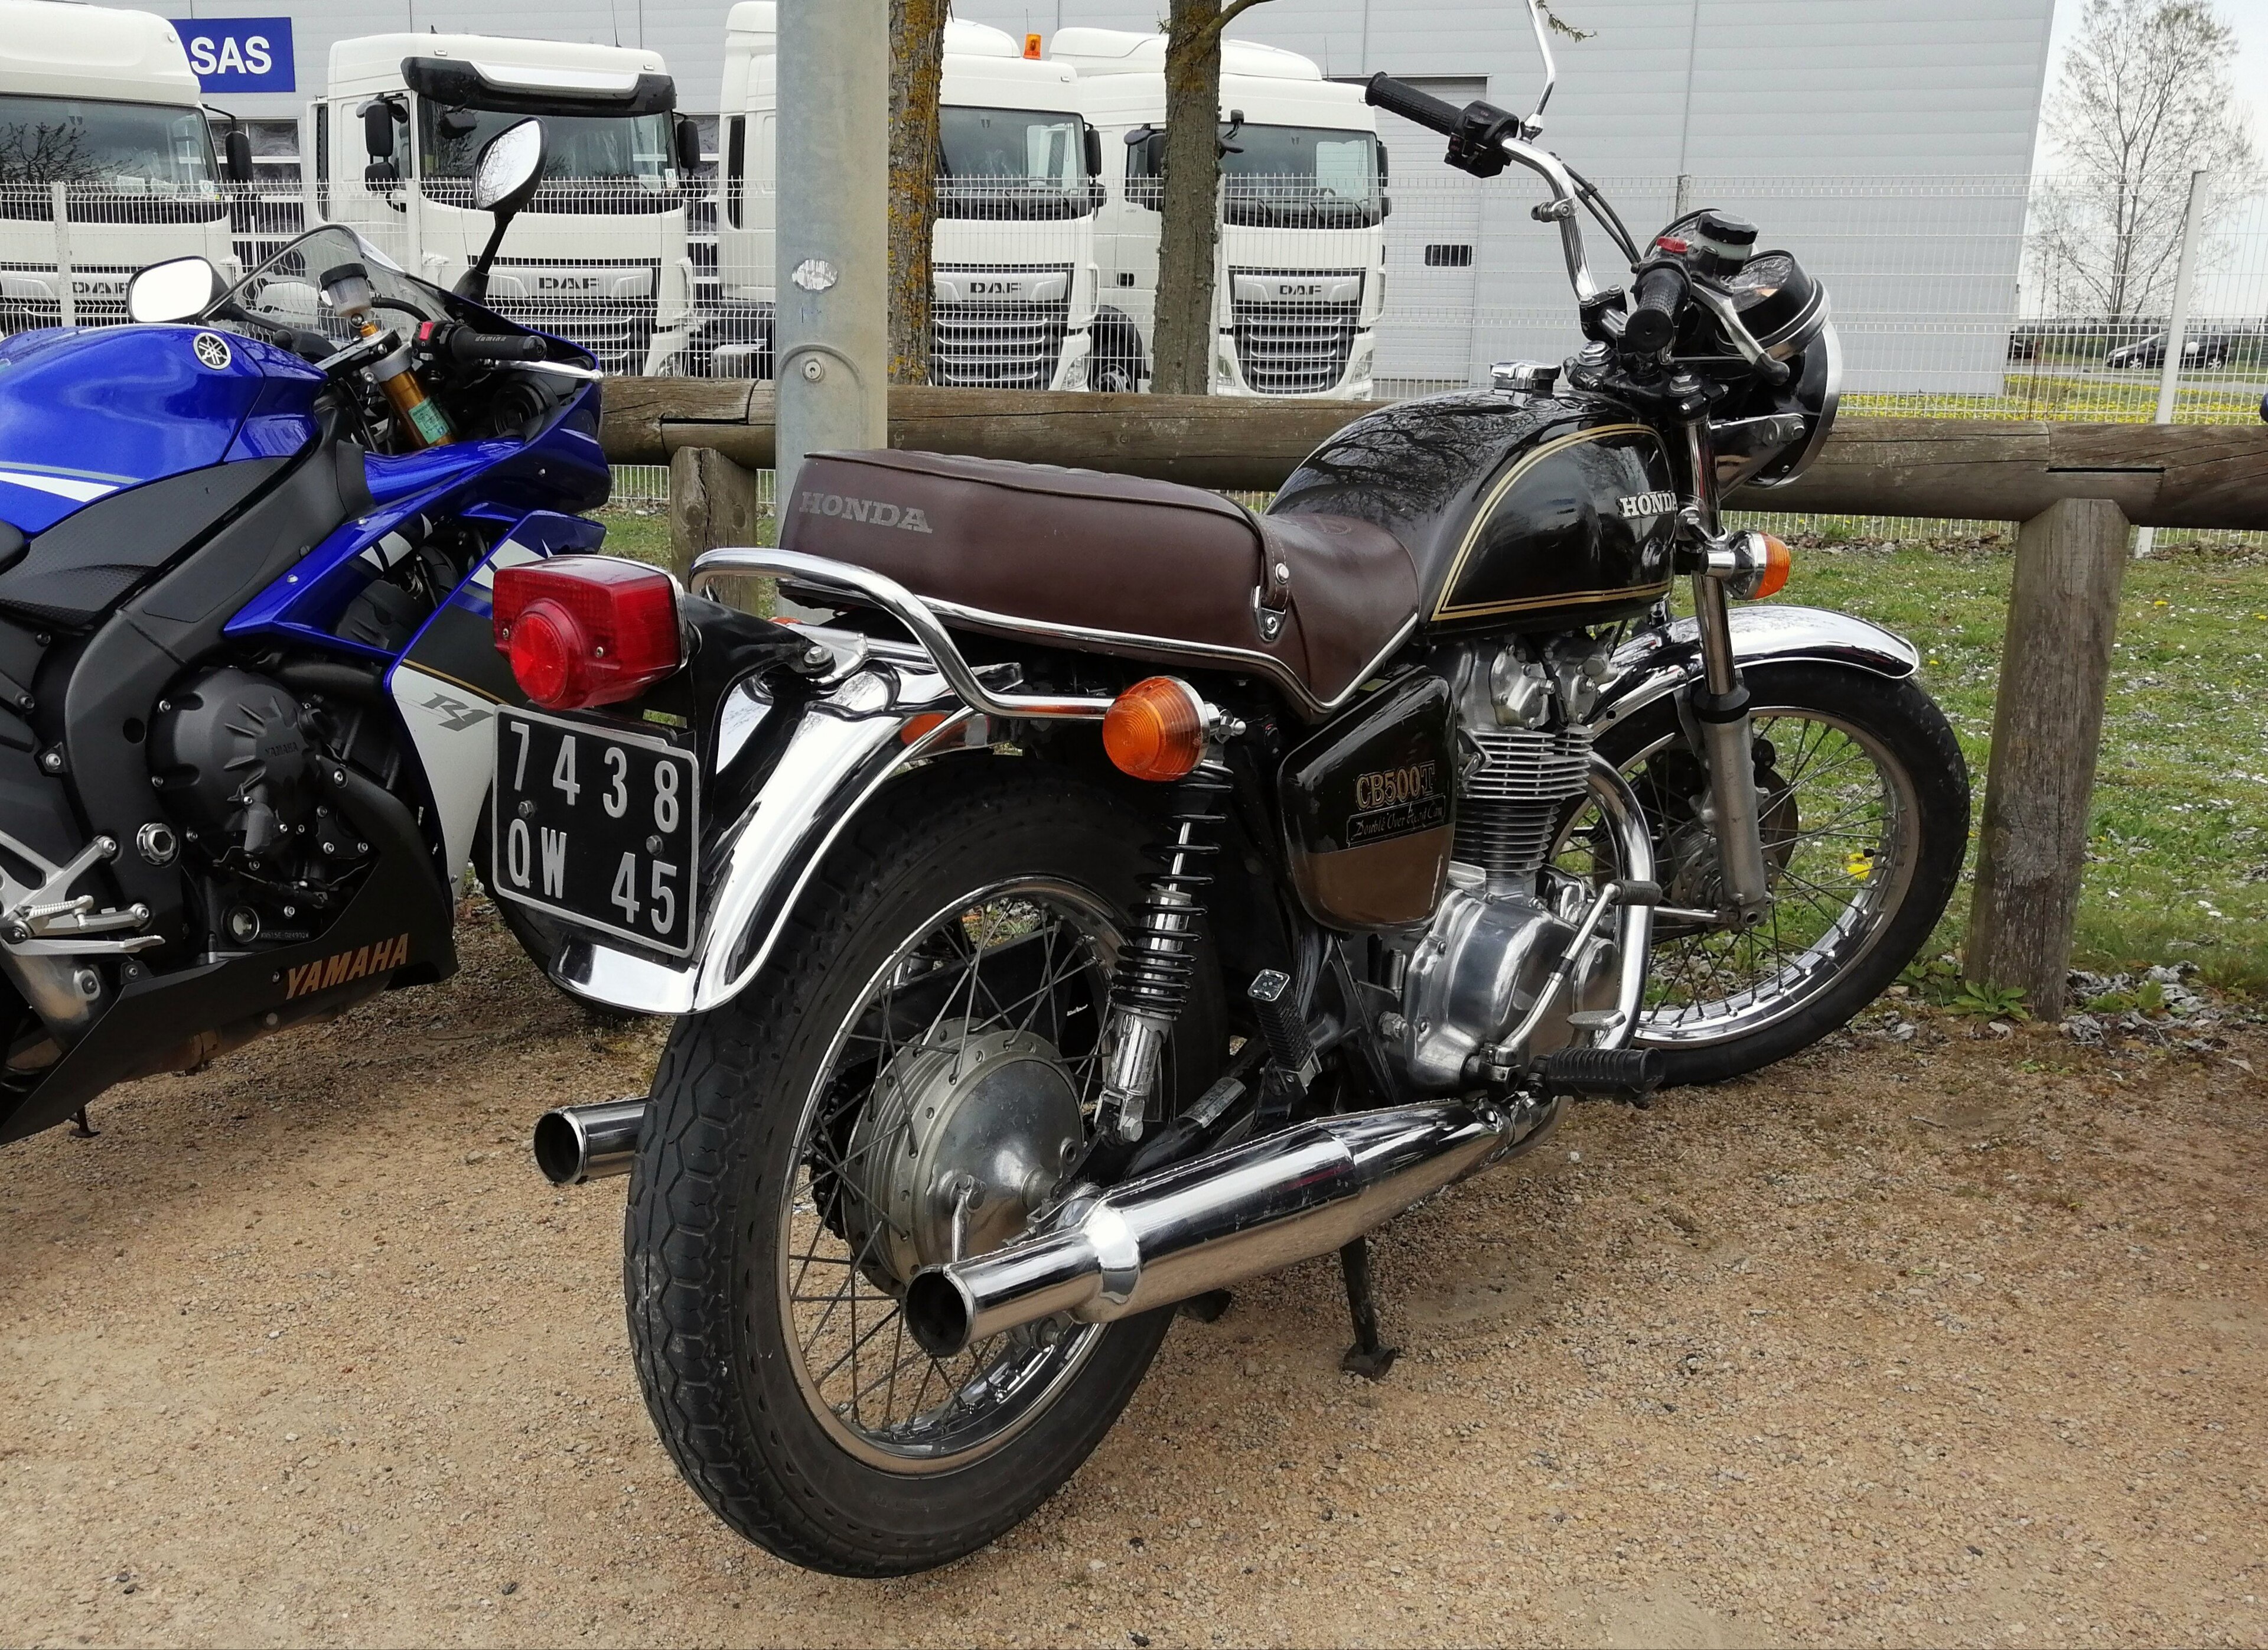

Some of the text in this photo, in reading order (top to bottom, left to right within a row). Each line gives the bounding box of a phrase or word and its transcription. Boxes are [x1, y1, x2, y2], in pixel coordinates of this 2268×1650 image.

[191, 36, 272, 74] SAS
[71, 282, 128, 294] DAF
[539, 277, 599, 289] DAF
[970, 282, 1021, 294] DAF
[1279, 285, 1321, 295] DAF
[799, 492, 933, 533] HONDA
[1619, 492, 1678, 518] HONDA
[510, 721, 679, 832] 7438
[1355, 760, 1435, 811] CB500T
[507, 819, 677, 935] QW 45
[286, 933, 409, 1000] YAMAHA
